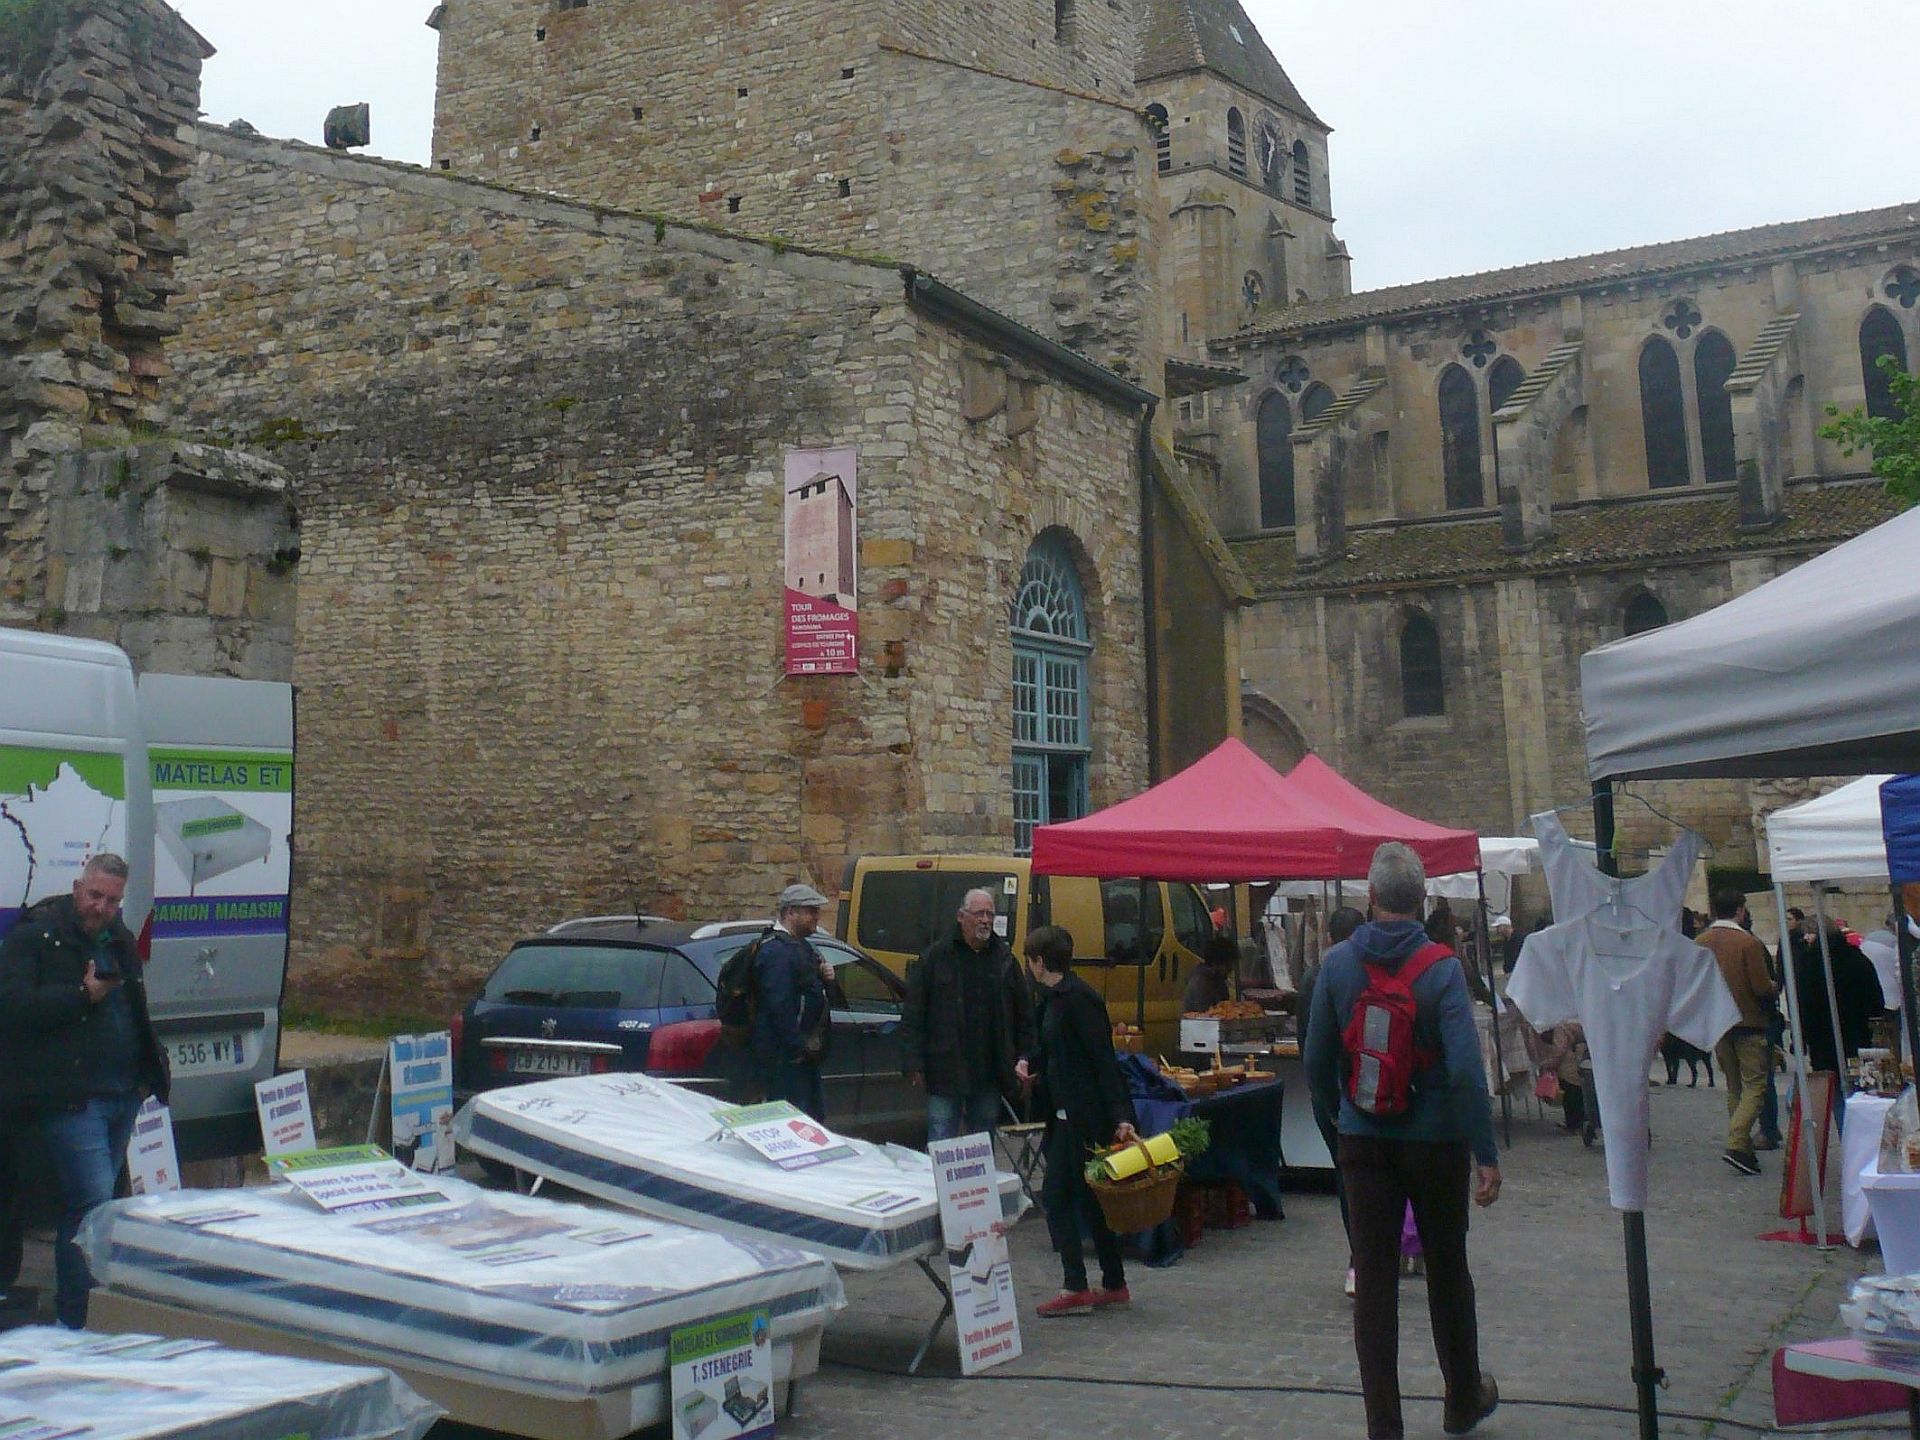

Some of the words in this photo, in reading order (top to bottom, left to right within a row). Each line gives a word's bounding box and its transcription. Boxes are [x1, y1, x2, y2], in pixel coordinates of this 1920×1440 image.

[791, 603, 812, 612] TOUR
[791, 614, 806, 623] DES
[807, 612, 849, 622] FROMAGES
[826, 648, 836, 657] 10
[155, 763, 248, 785] MATELAS
[259, 767, 283, 785] ET
[215, 901, 283, 921] MAGASIN
[618, 1020, 638, 1029] 407
[747, 1127, 781, 1142] STOP
[954, 1162, 986, 1180] sommiers
[691, 1364, 701, 1384] T.
[701, 1349, 753, 1380] STENEGRIE
